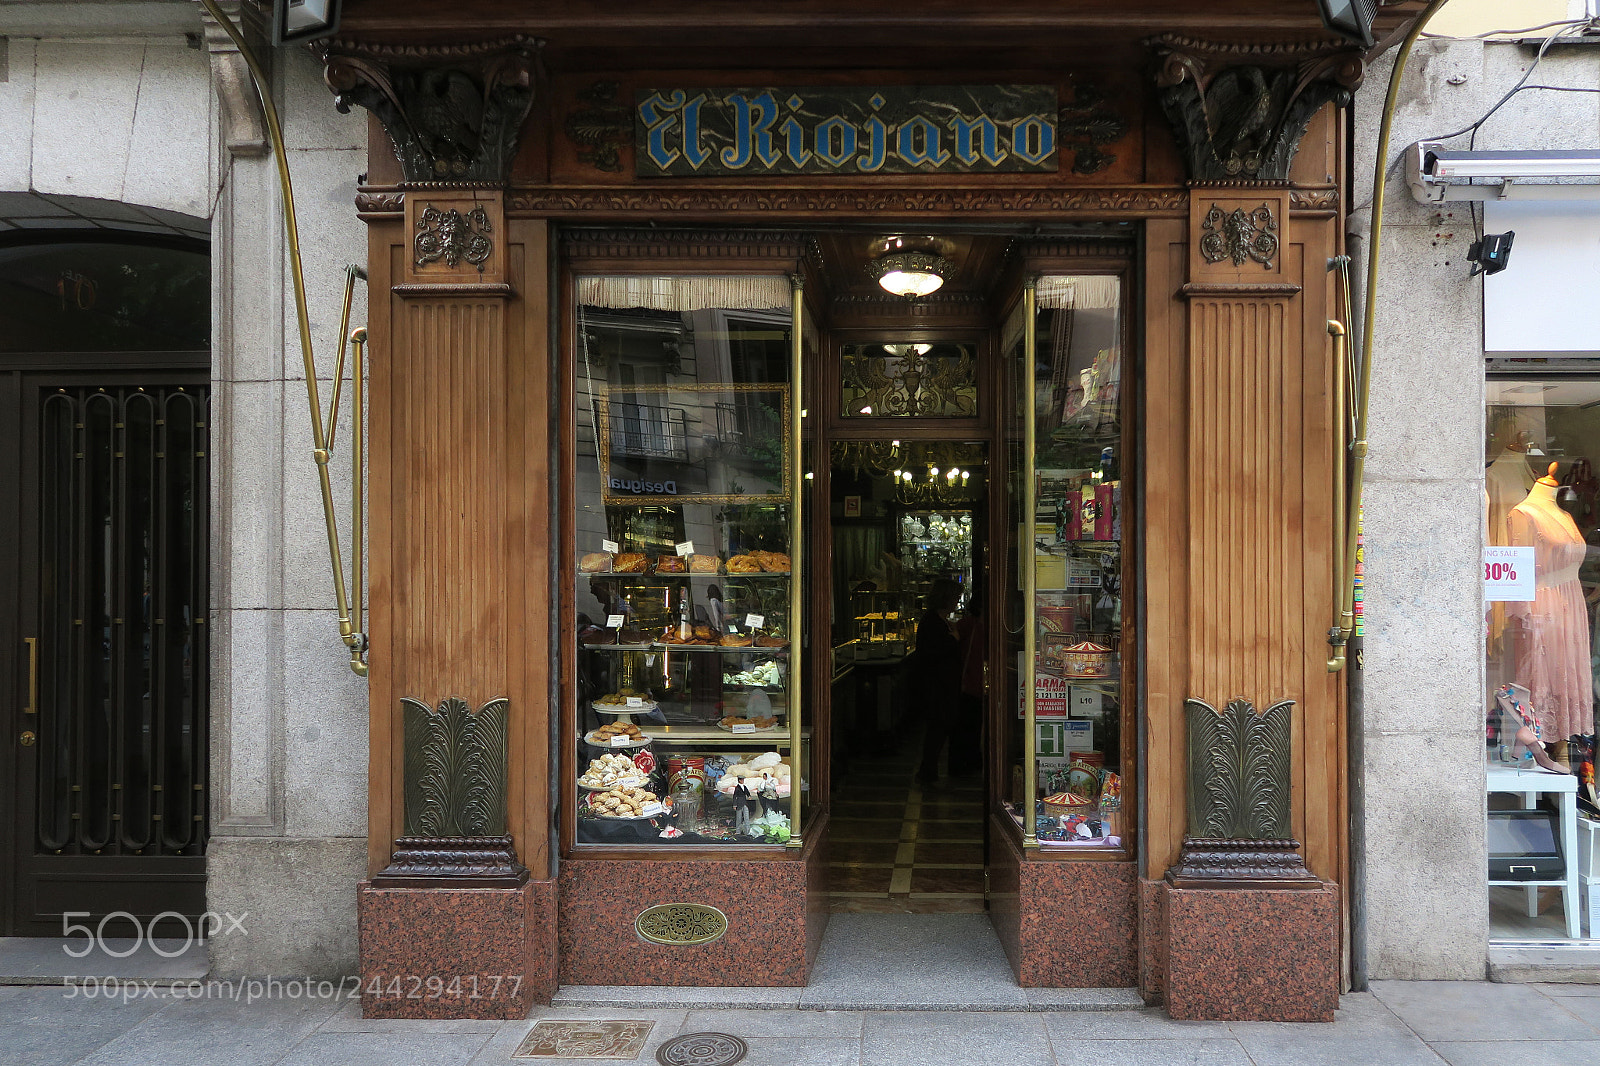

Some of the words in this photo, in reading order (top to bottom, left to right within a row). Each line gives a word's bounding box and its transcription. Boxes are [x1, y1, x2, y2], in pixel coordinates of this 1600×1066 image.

[638, 89, 713, 171] El
[719, 91, 1056, 172] Riojano
[1036, 724, 1062, 754] H
